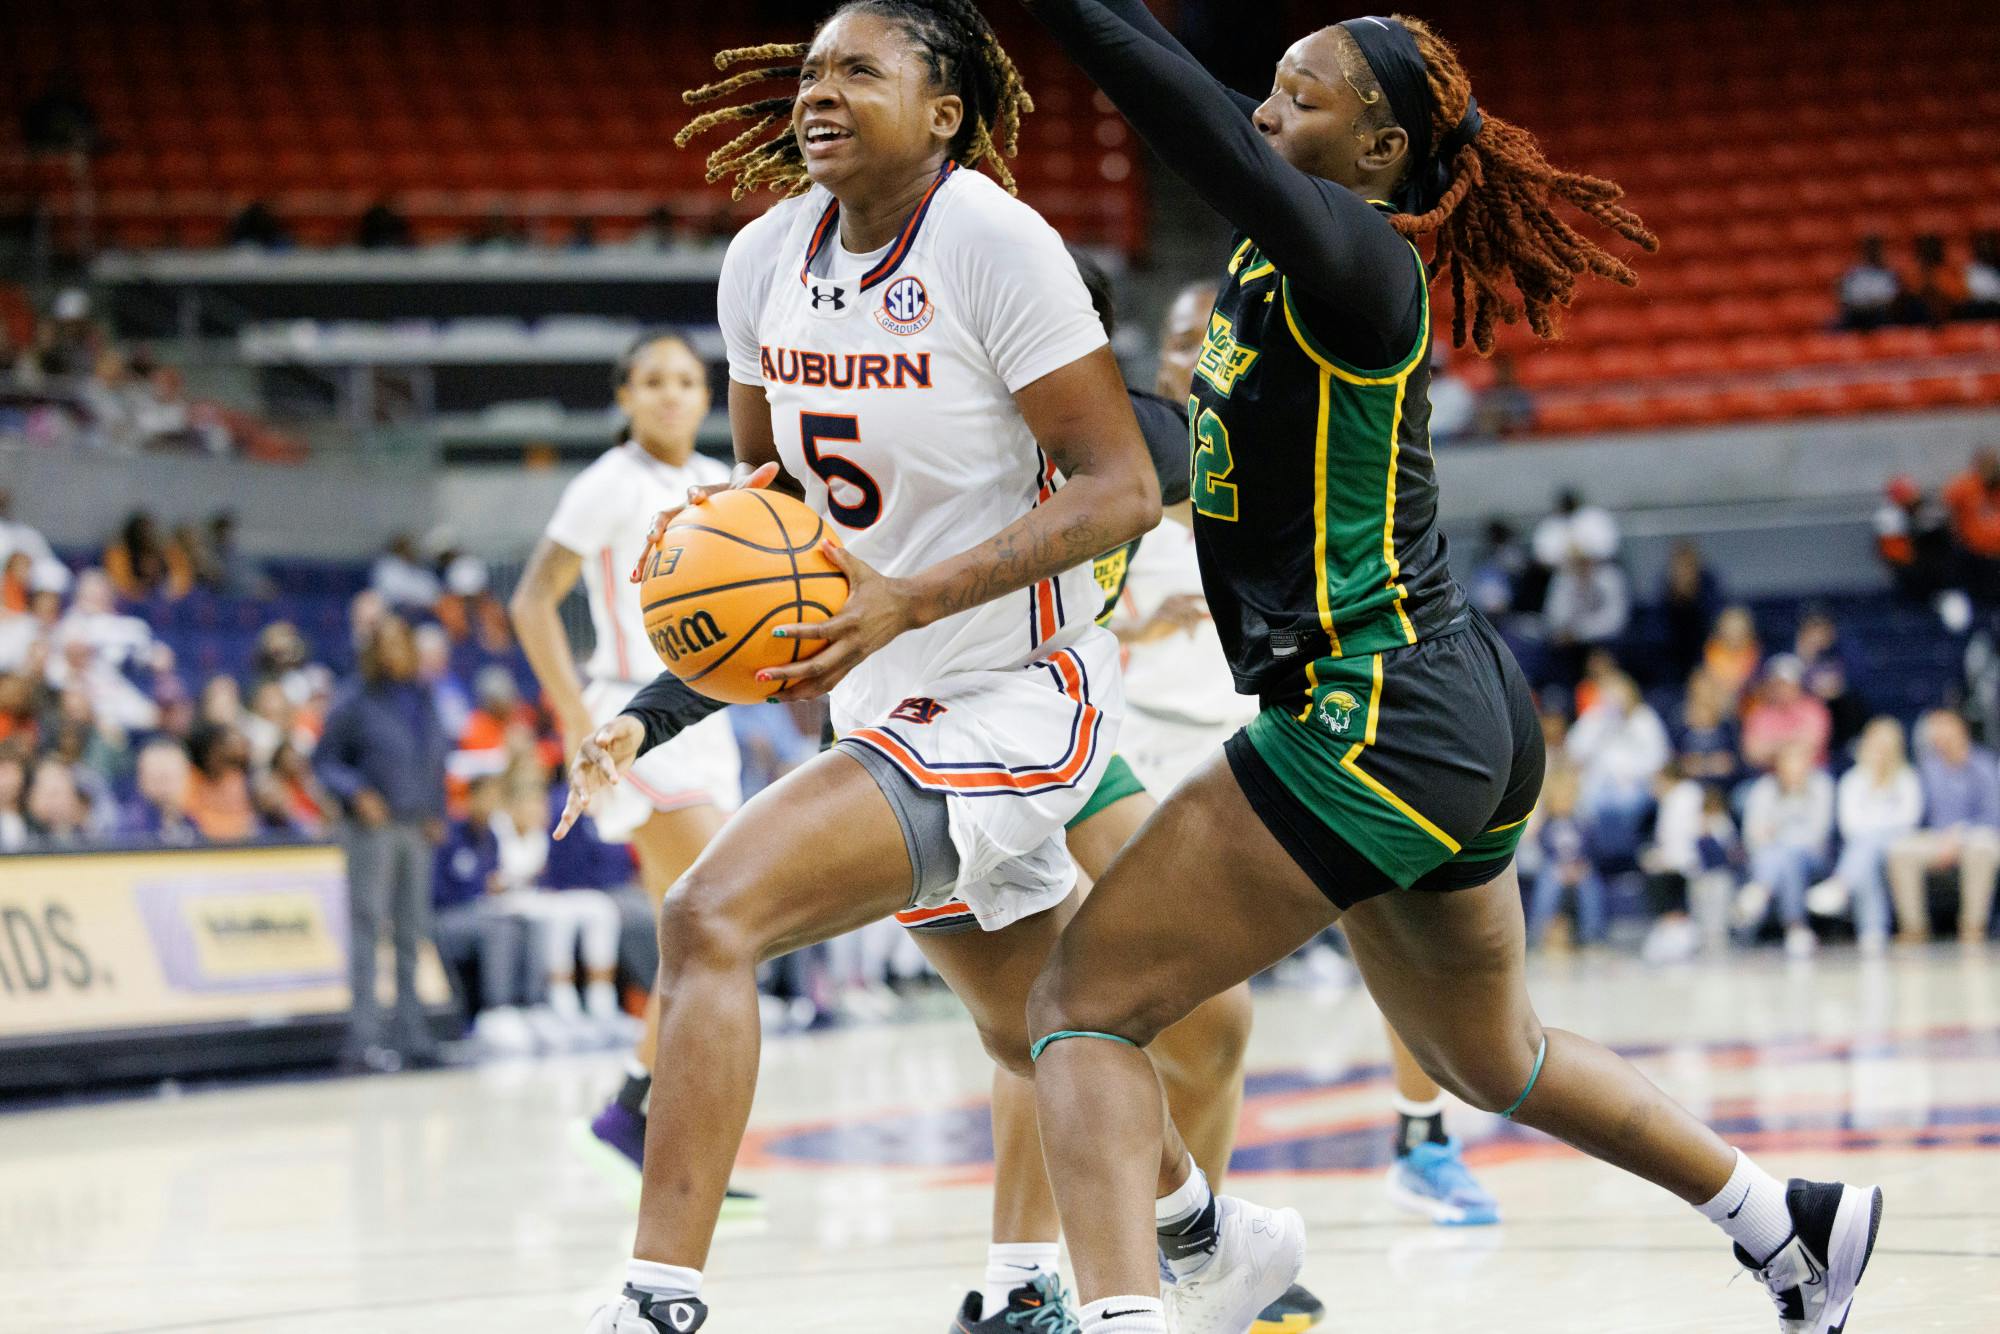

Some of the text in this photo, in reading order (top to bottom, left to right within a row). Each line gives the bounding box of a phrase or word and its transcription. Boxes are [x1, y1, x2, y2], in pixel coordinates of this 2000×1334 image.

[887, 279, 925, 320] SEC
[881, 315, 929, 334] GRADUATE
[760, 345, 933, 390] AUBURN
[799, 410, 883, 531] 5
